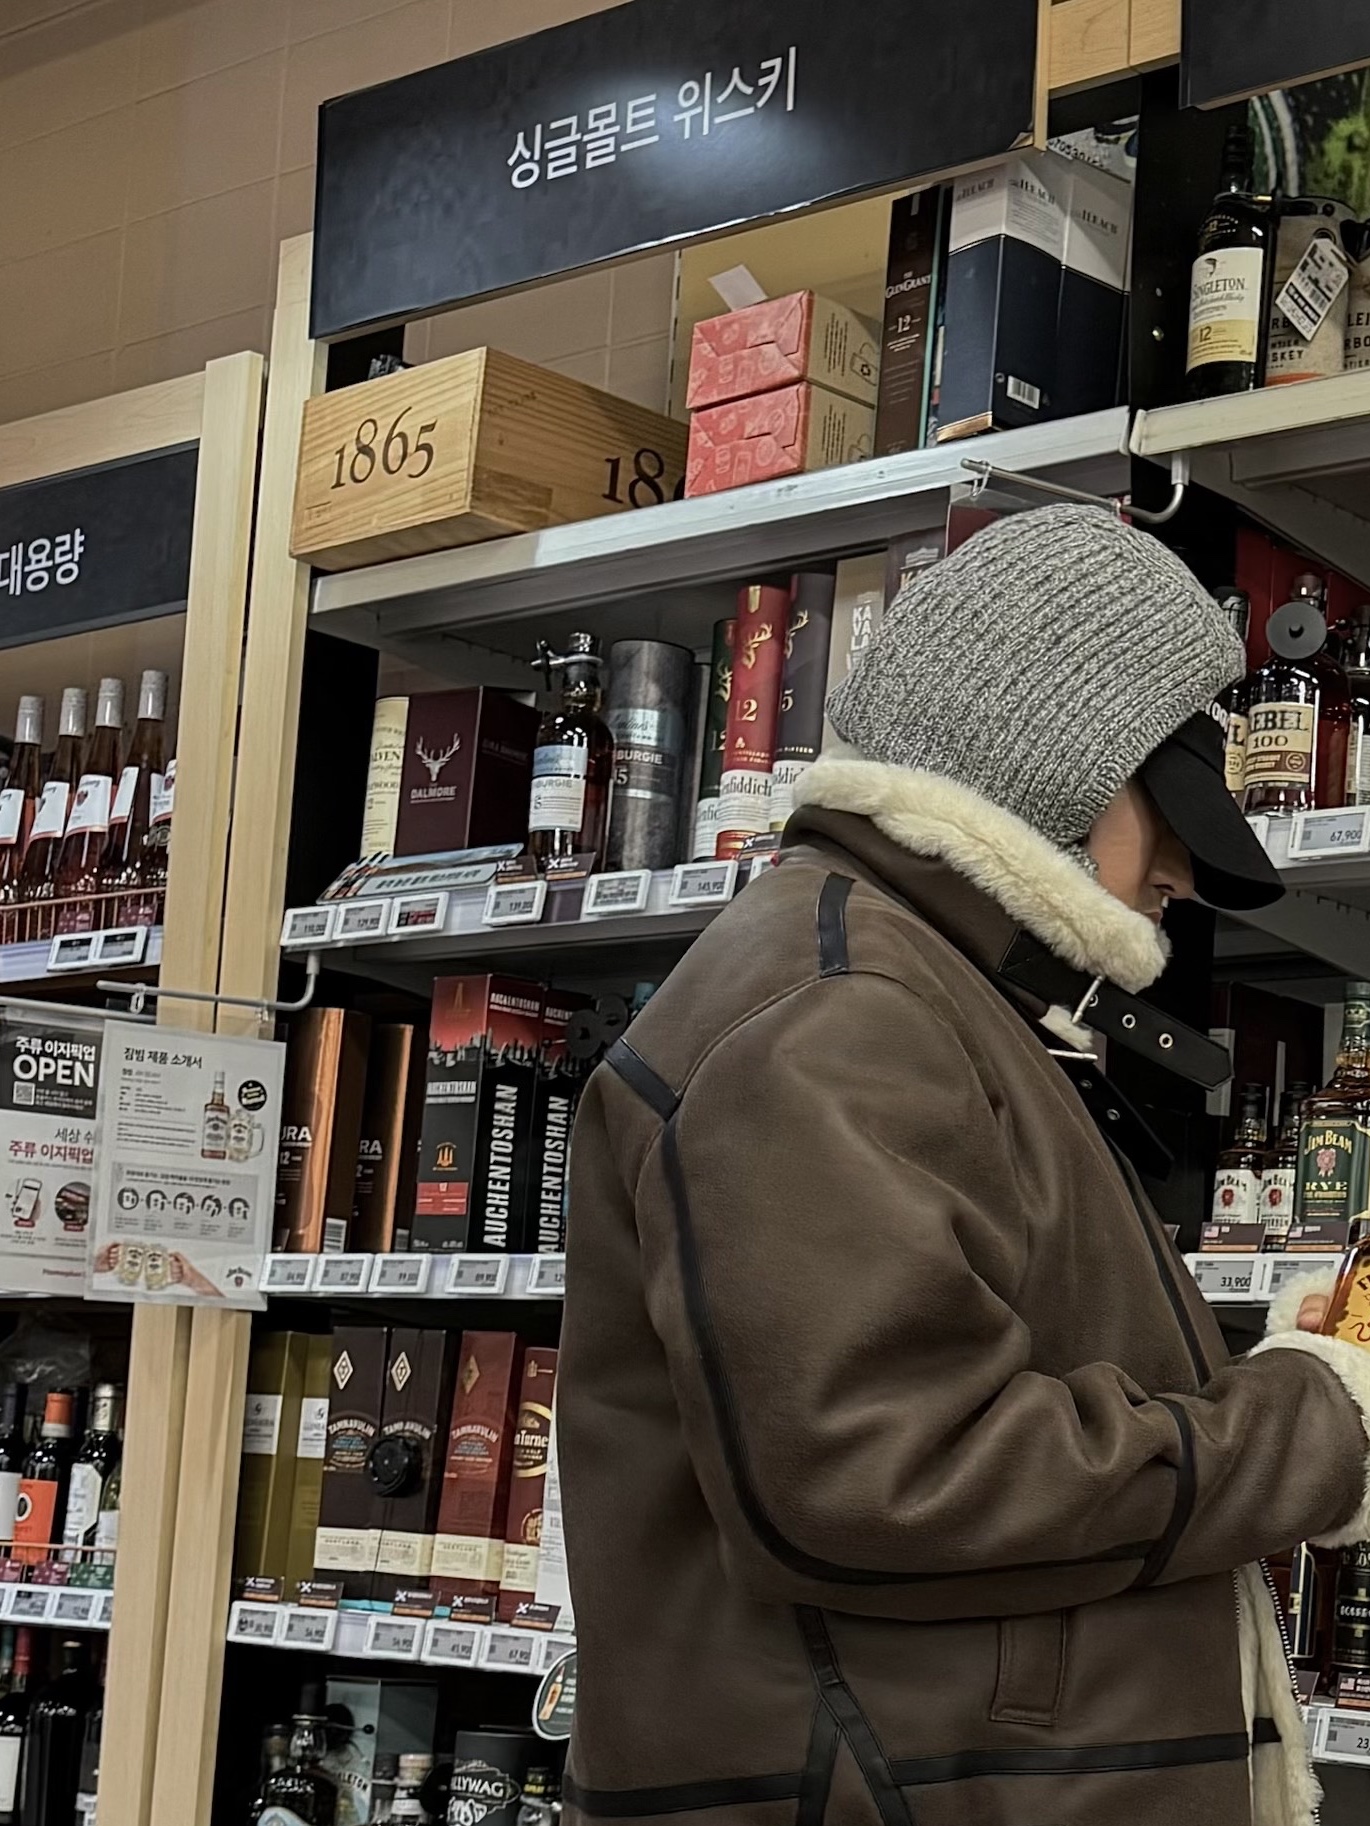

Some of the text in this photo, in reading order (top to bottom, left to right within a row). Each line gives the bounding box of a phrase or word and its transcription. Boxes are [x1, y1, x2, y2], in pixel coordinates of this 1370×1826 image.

[506, 46, 797, 189] 싱글몰트 위스키
[331, 405, 438, 493] 1865
[602, 447, 686, 511] 18
[1252, 735, 1288, 749] 100
[410, 784, 457, 800] DALMORE
[1329, 829, 1362, 843] 67,900
[16, 1036, 96, 1062] 주류 이지픽업
[12, 1053, 95, 1088] OPEN
[54, 1126, 81, 1142] 세상
[9, 1140, 37, 1159] 주류
[482, 1083, 519, 1249] AUCHENTOSHAN
[1305, 1180, 1349, 1192] RYE
[1220, 1276, 1252, 1288] 33,900
